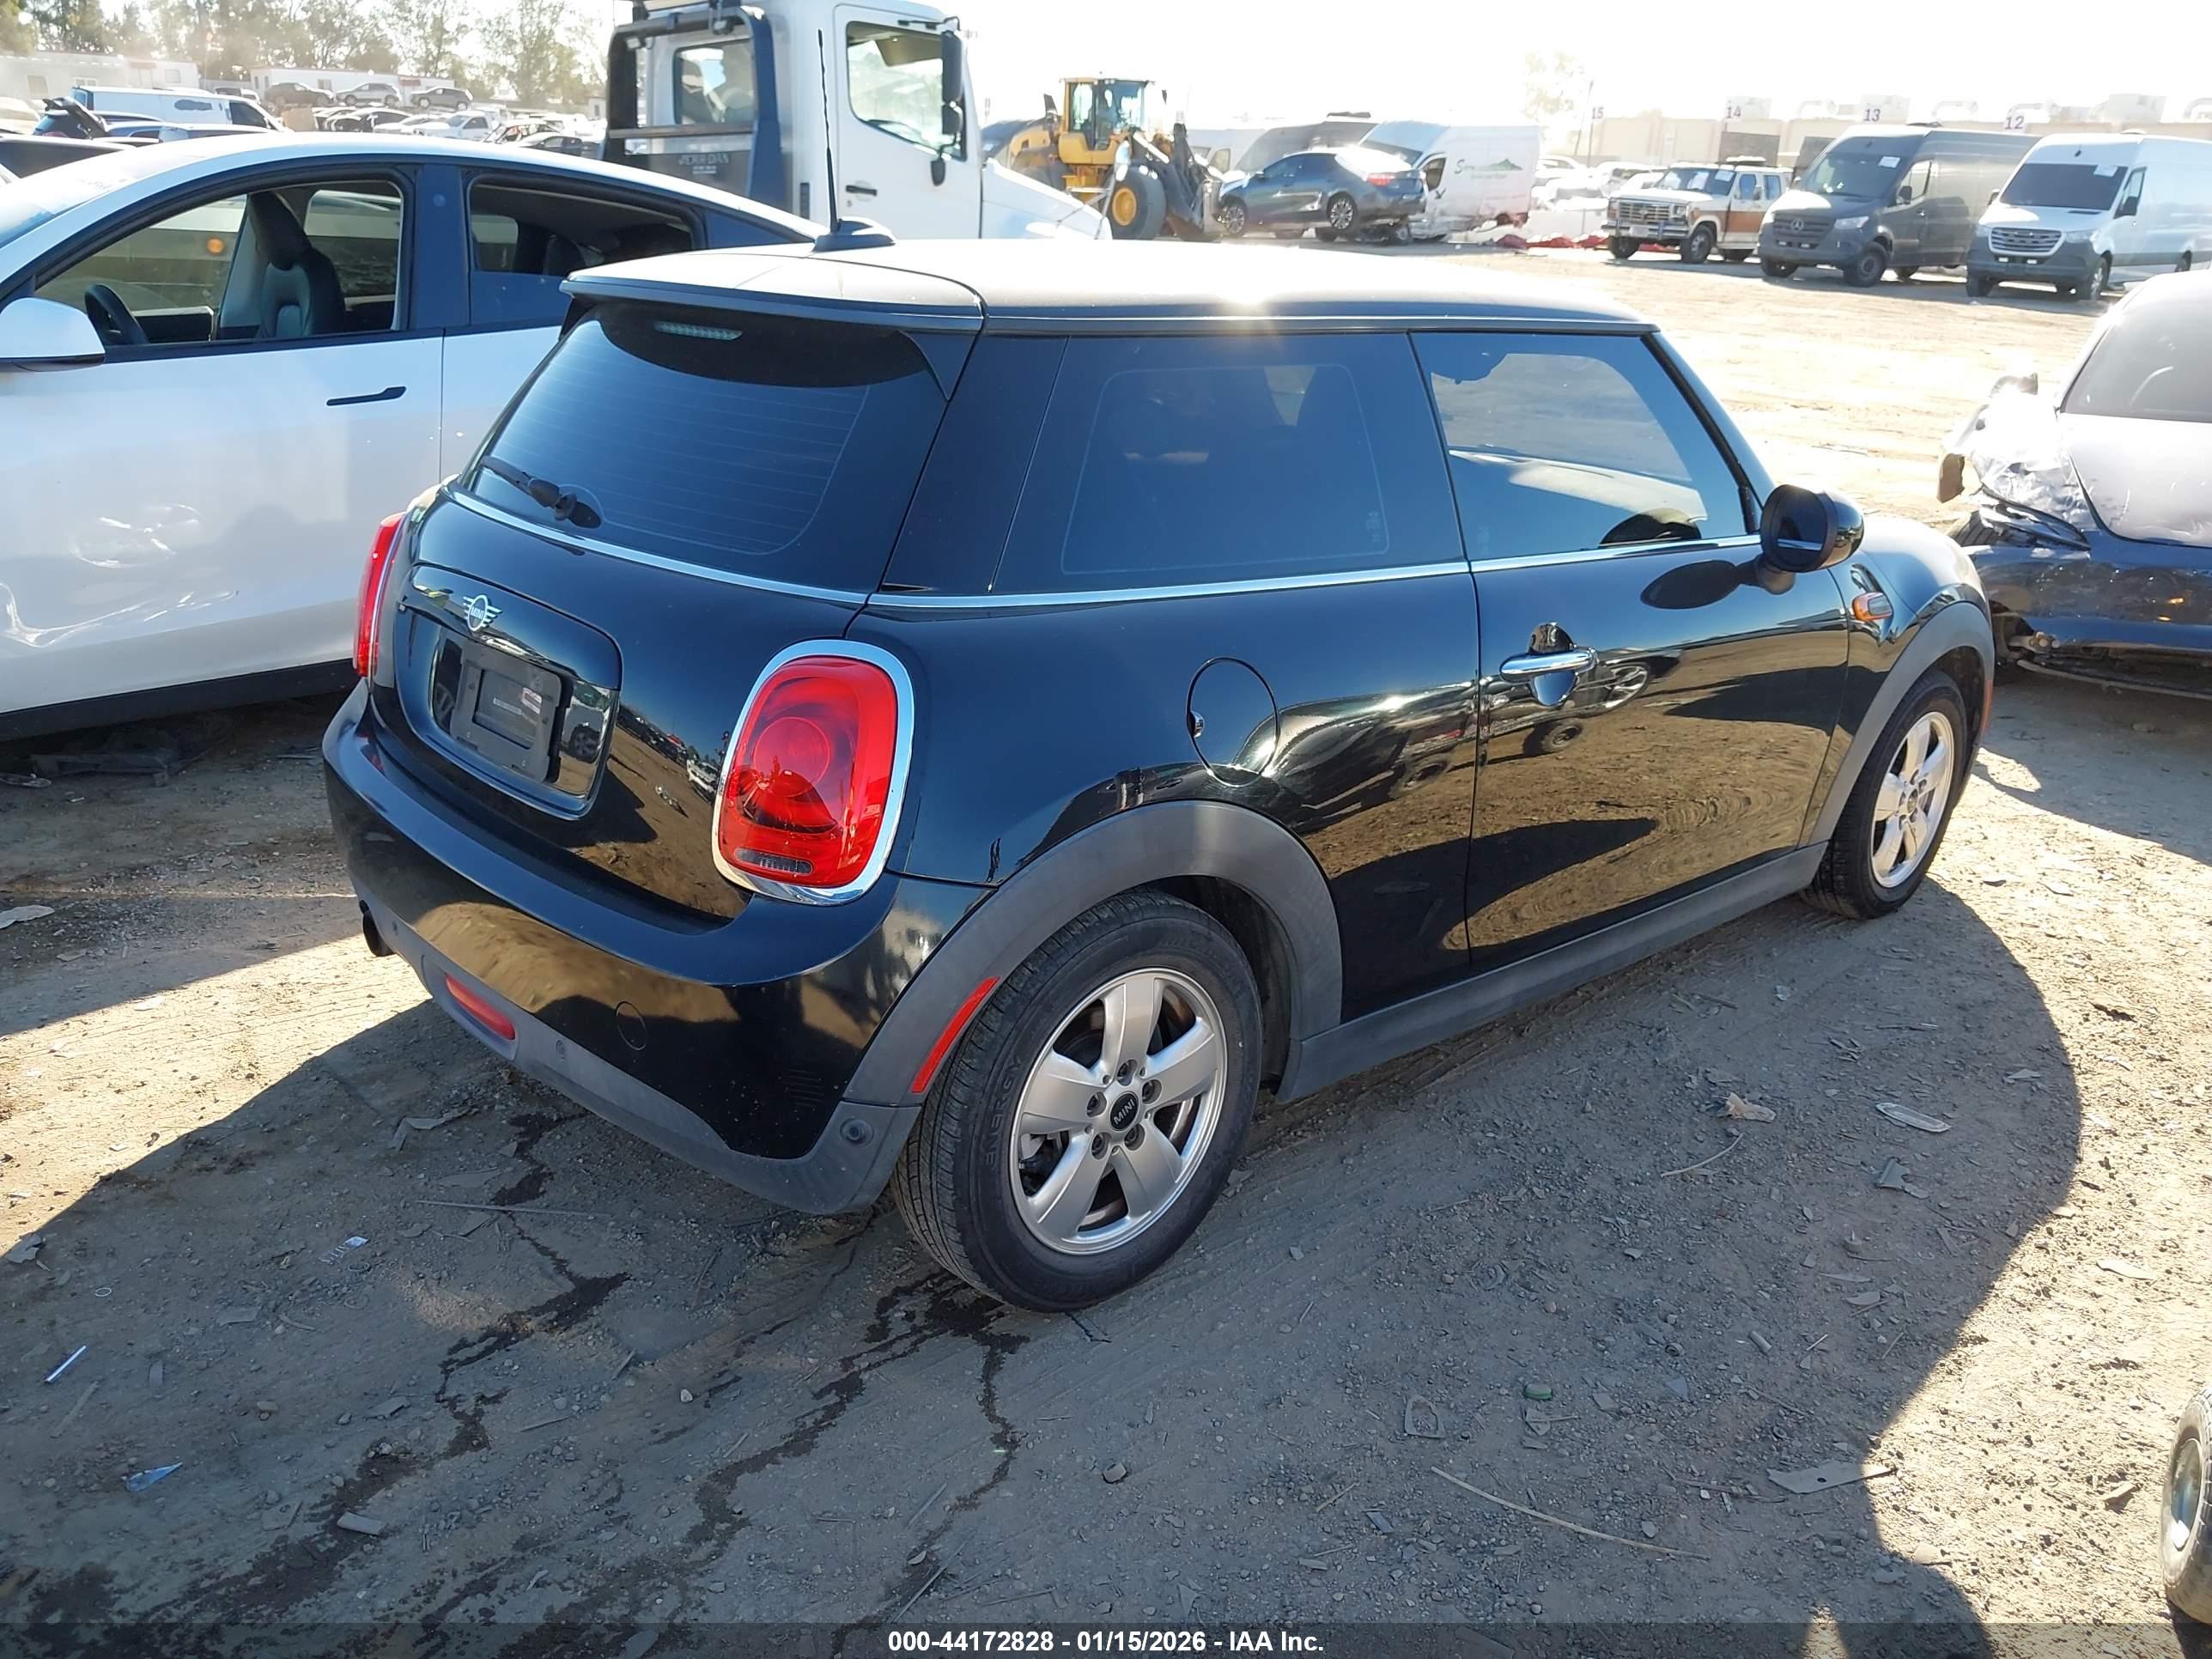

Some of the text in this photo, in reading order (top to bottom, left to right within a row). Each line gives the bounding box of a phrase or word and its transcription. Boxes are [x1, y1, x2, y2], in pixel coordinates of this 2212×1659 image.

[1591, 106, 1604, 119] 15
[1726, 106, 1741, 119] 14
[1863, 108, 1881, 122] 13
[2004, 116, 2024, 130] 12
[470, 605, 485, 620] MINI
[985, 1054, 1022, 1166] ENERGY
[1113, 1098, 1135, 1125] MINI
